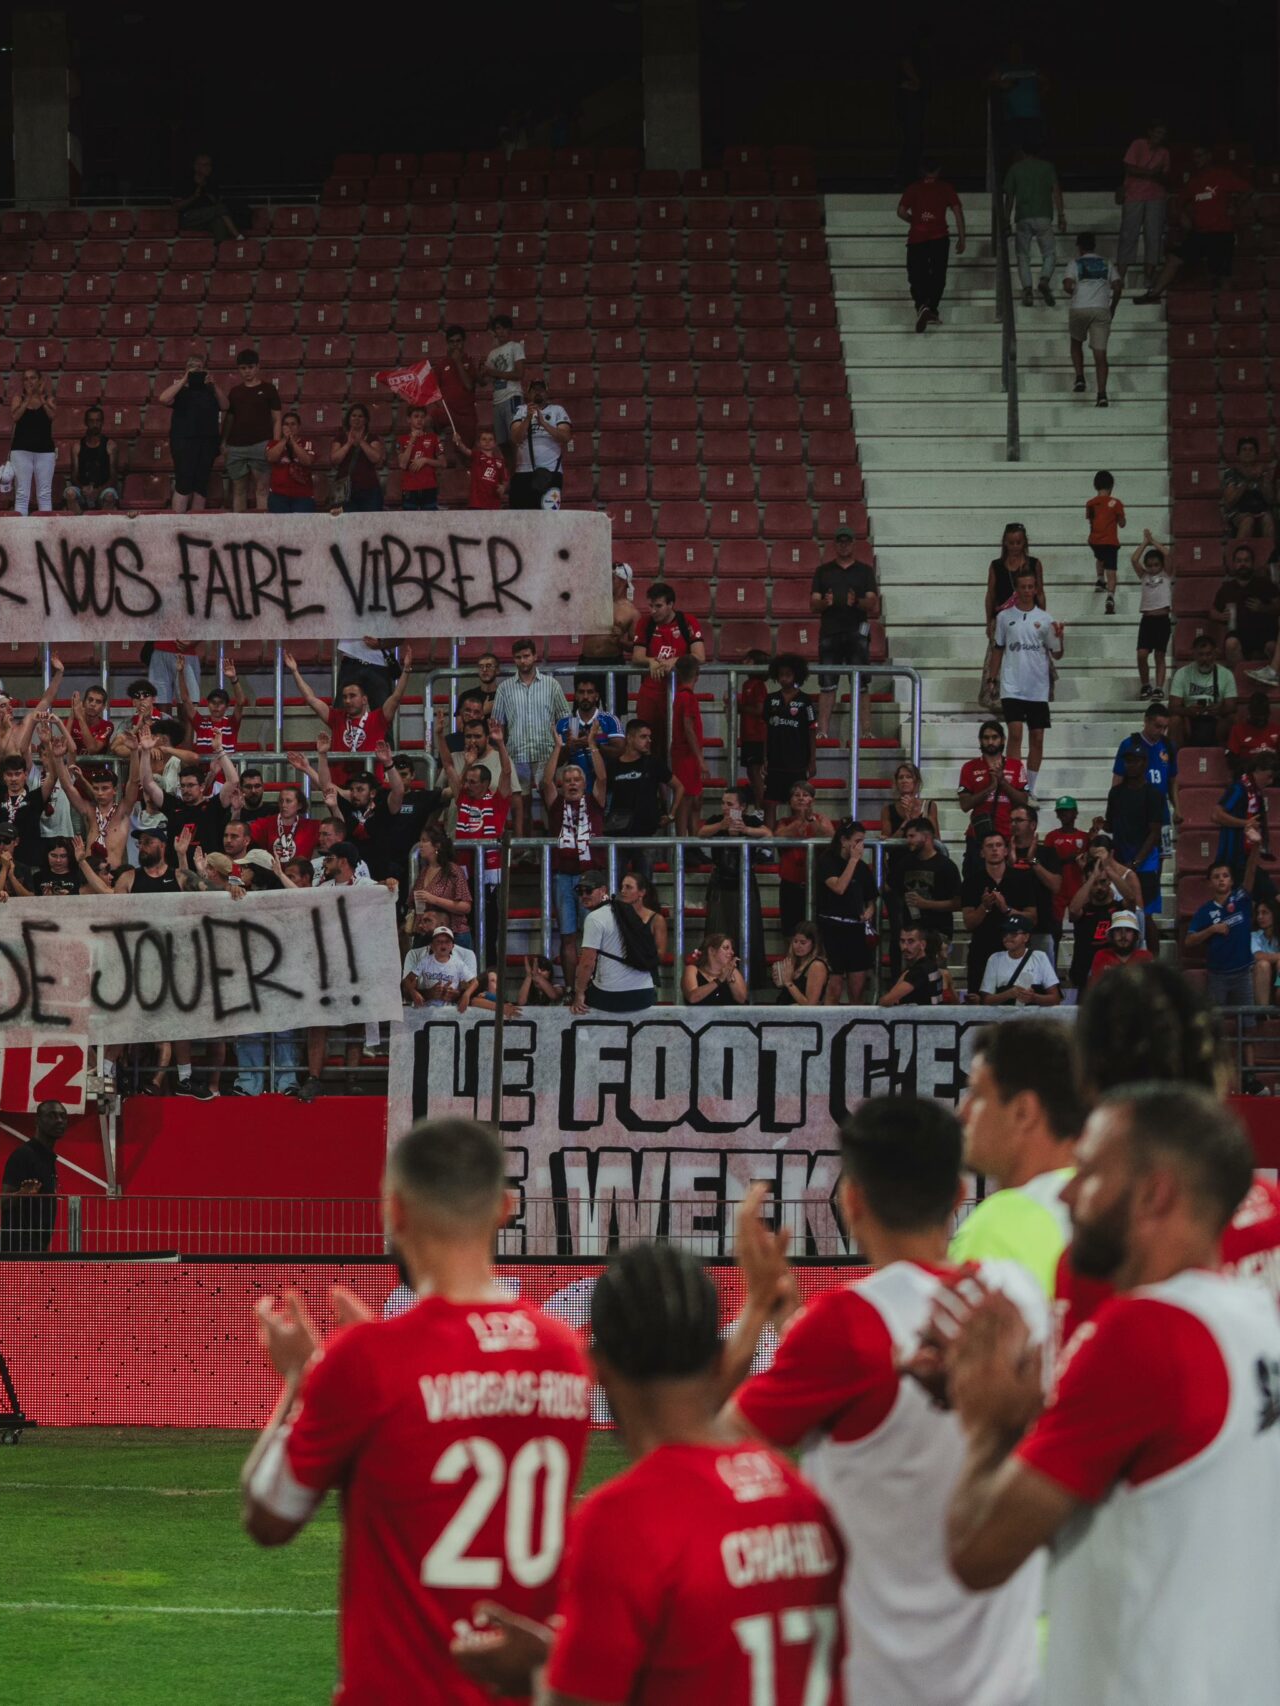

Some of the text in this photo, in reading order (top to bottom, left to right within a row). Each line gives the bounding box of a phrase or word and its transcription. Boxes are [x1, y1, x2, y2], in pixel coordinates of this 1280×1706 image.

[34, 537, 162, 618] NOUS
[176, 532, 326, 622] FAIRE
[329, 534, 533, 619] VIBRER
[1148, 768, 1162, 785] 13
[89, 916, 305, 1022] JOUER
[414, 1020, 536, 1130] LE
[559, 1020, 823, 1132] FOOT
[422, 1436, 570, 1589] 20
[733, 1606, 839, 1706] 17
